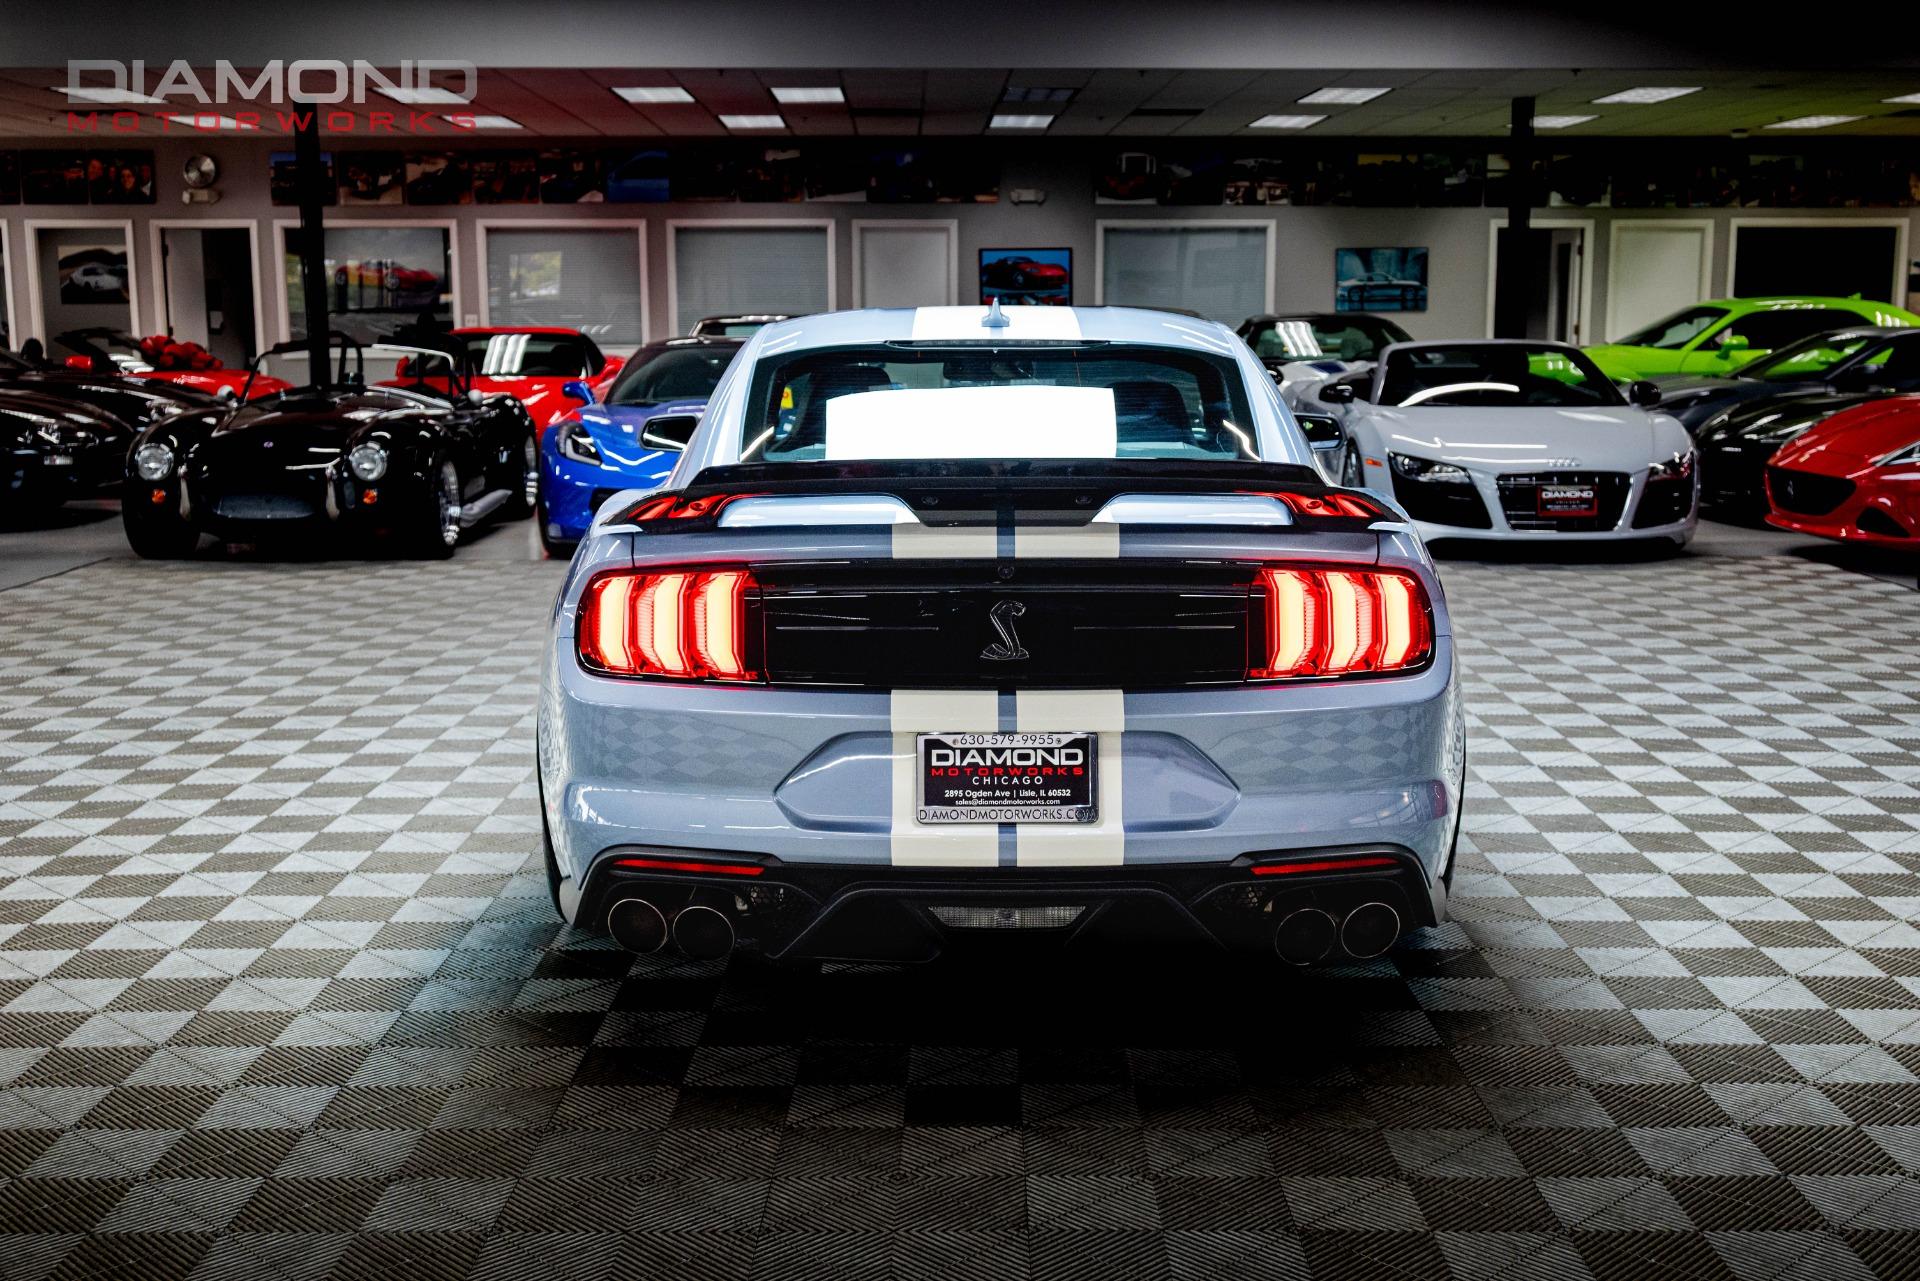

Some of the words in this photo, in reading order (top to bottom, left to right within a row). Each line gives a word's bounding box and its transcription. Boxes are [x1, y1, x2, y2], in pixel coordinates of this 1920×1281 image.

[1542, 490, 1594, 499] DIAMOND
[960, 735, 1054, 745] 630-579-9955
[931, 748, 1083, 766] DIAMOND
[932, 767, 1084, 776] MOTORWORKS
[972, 776, 1043, 785] CHICAGO
[944, 789, 963, 797] 2895
[965, 789, 992, 798] Ogden
[994, 789, 1010, 797] Ave
[1019, 789, 1038, 798] Lisle,
[1040, 789, 1046, 797] IL
[1048, 789, 1071, 797] 60532
[919, 809, 1096, 821] DIAMONDMOTORWORKS.COM
